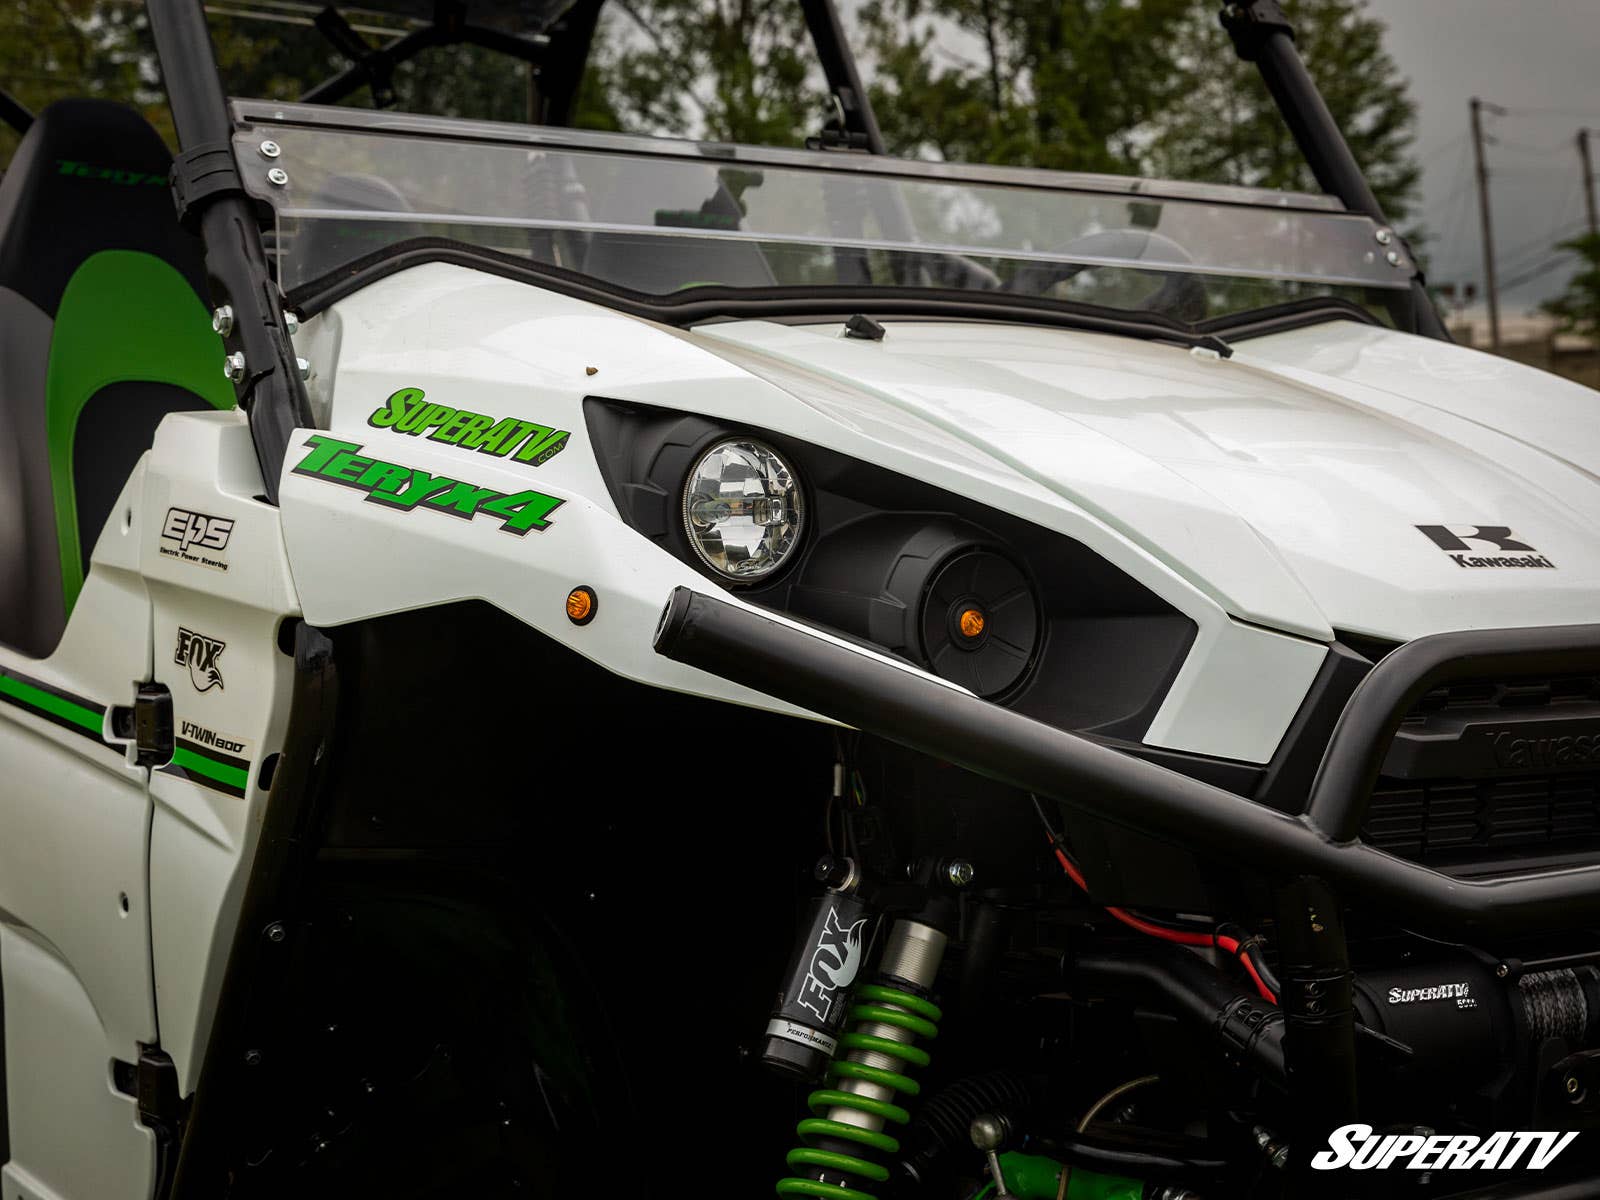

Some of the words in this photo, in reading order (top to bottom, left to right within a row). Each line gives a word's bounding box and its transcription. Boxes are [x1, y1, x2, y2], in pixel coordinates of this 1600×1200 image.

[162, 507, 235, 551] EPS
[181, 552, 200, 562] Power
[201, 557, 228, 571] Steering
[1449, 554, 1556, 569] Kawasaki
[175, 627, 225, 674] FOX
[797, 906, 854, 1023] FOX
